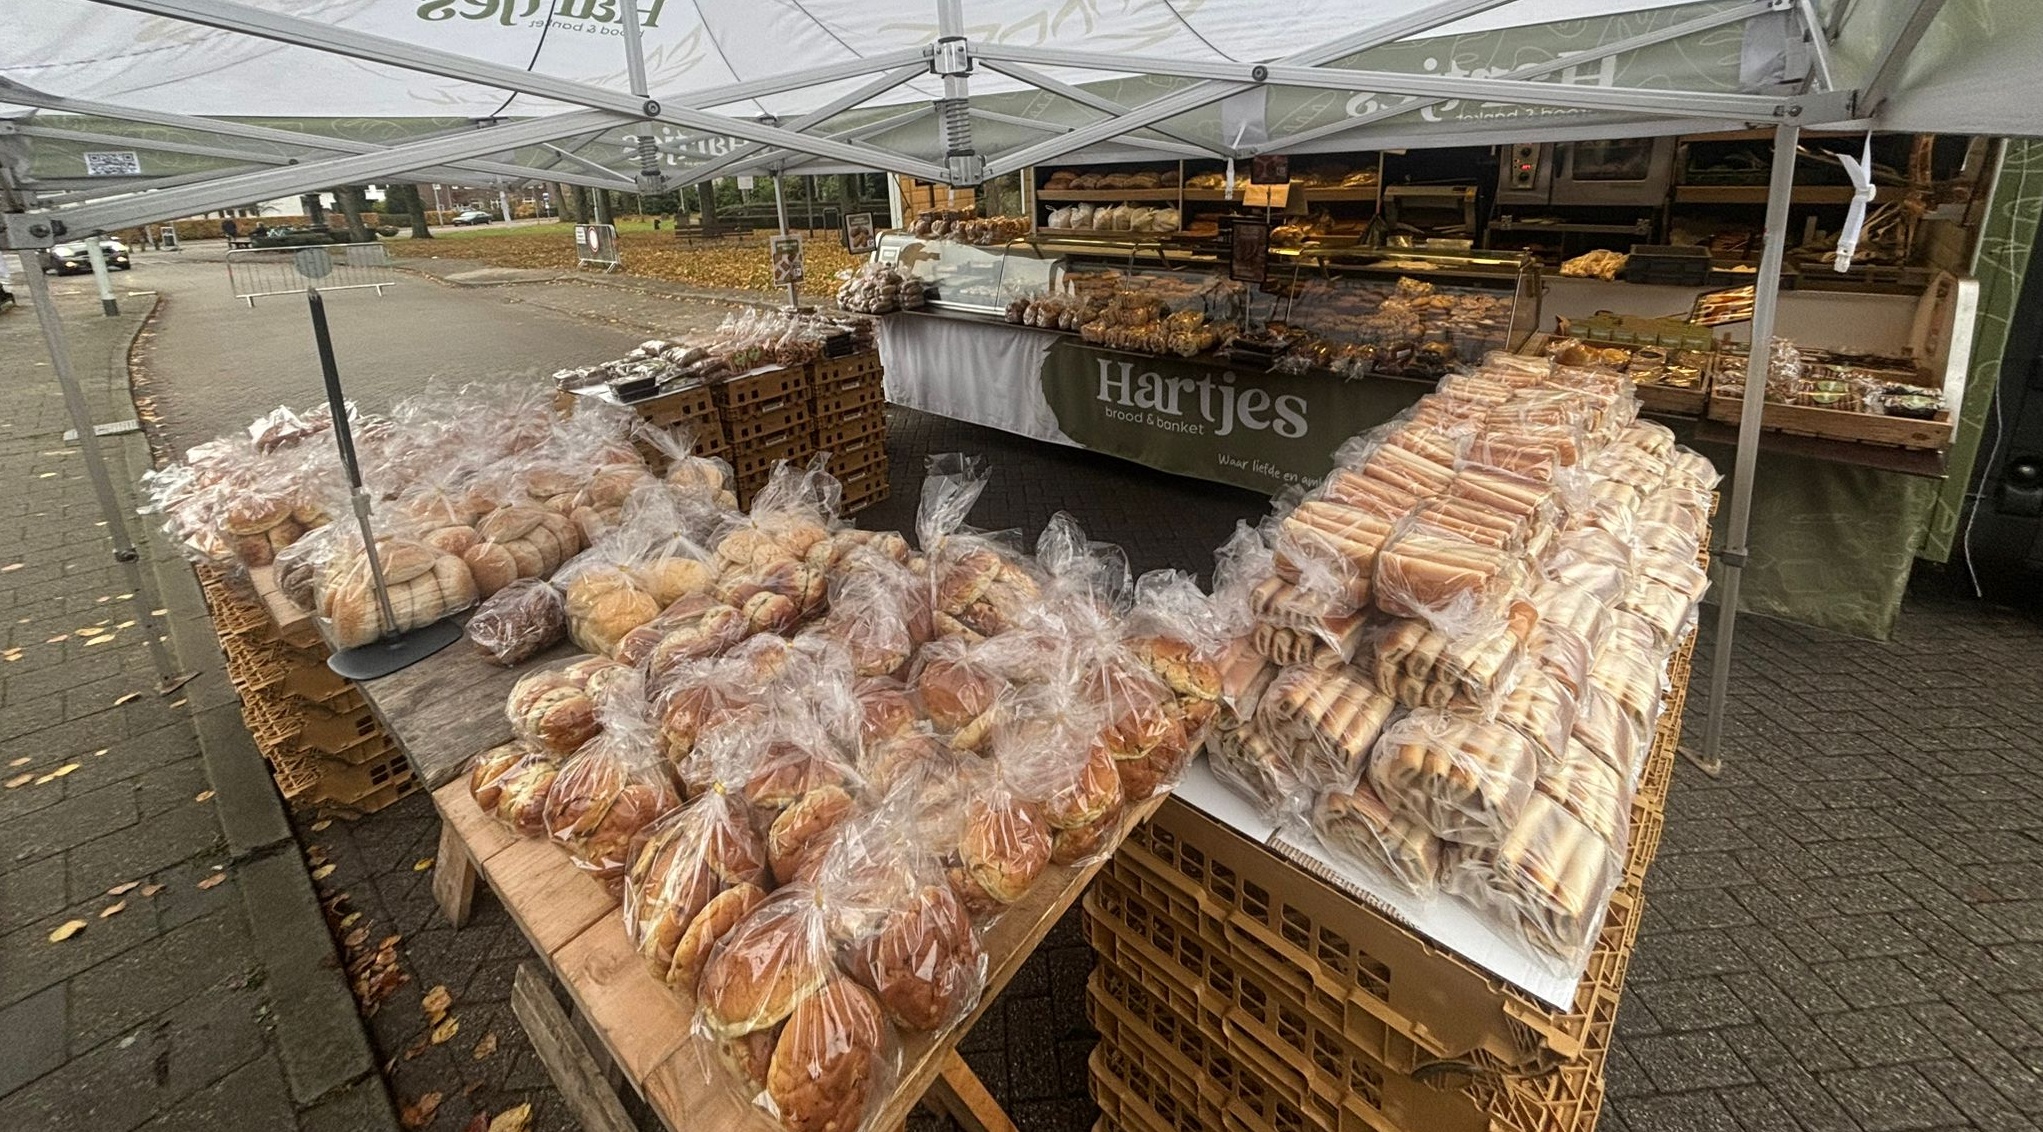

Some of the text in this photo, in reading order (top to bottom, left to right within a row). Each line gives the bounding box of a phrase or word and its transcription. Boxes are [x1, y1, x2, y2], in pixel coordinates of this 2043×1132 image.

[1096, 358, 1309, 438] Hartjes
[1105, 406, 1205, 436] brood & banket
[1218, 453, 1249, 470] Waar
[1252, 460, 1281, 479] liefde
[1283, 472, 1298, 482] en
